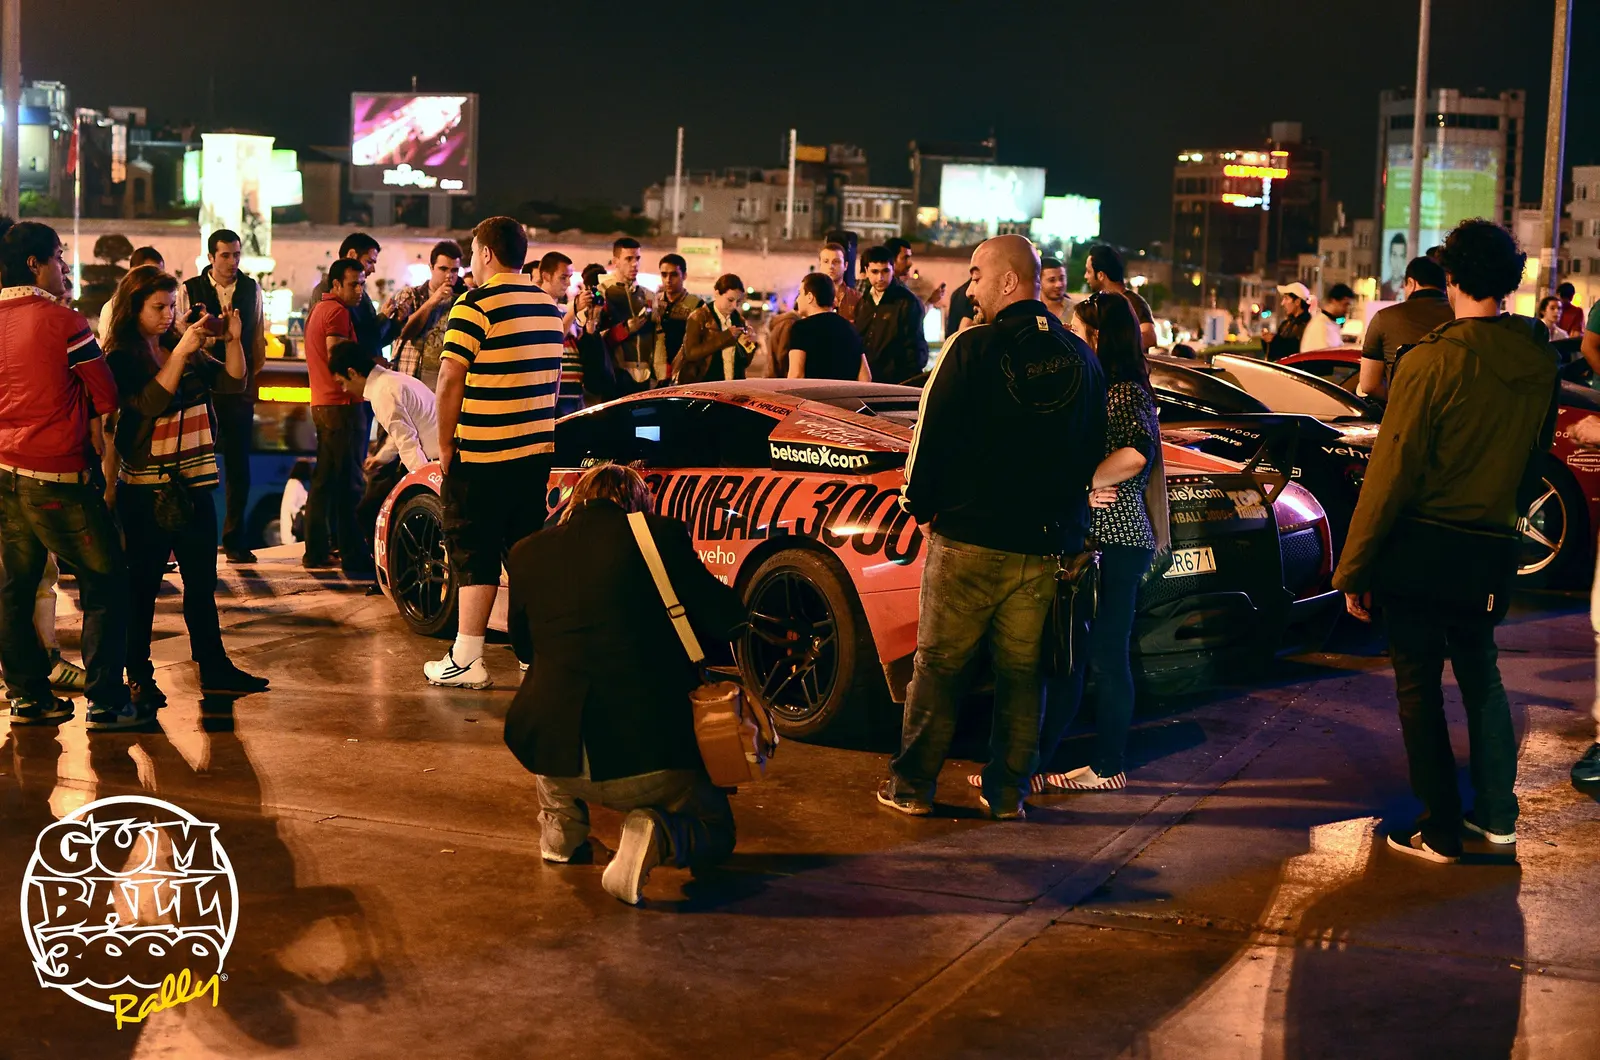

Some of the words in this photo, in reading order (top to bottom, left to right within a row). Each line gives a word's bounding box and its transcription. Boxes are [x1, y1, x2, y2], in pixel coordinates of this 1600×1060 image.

[757, 402, 793, 417] HAUGEN
[793, 480, 924, 566] 3000
[699, 544, 736, 565] veho
[1170, 549, 1212, 573] R671
